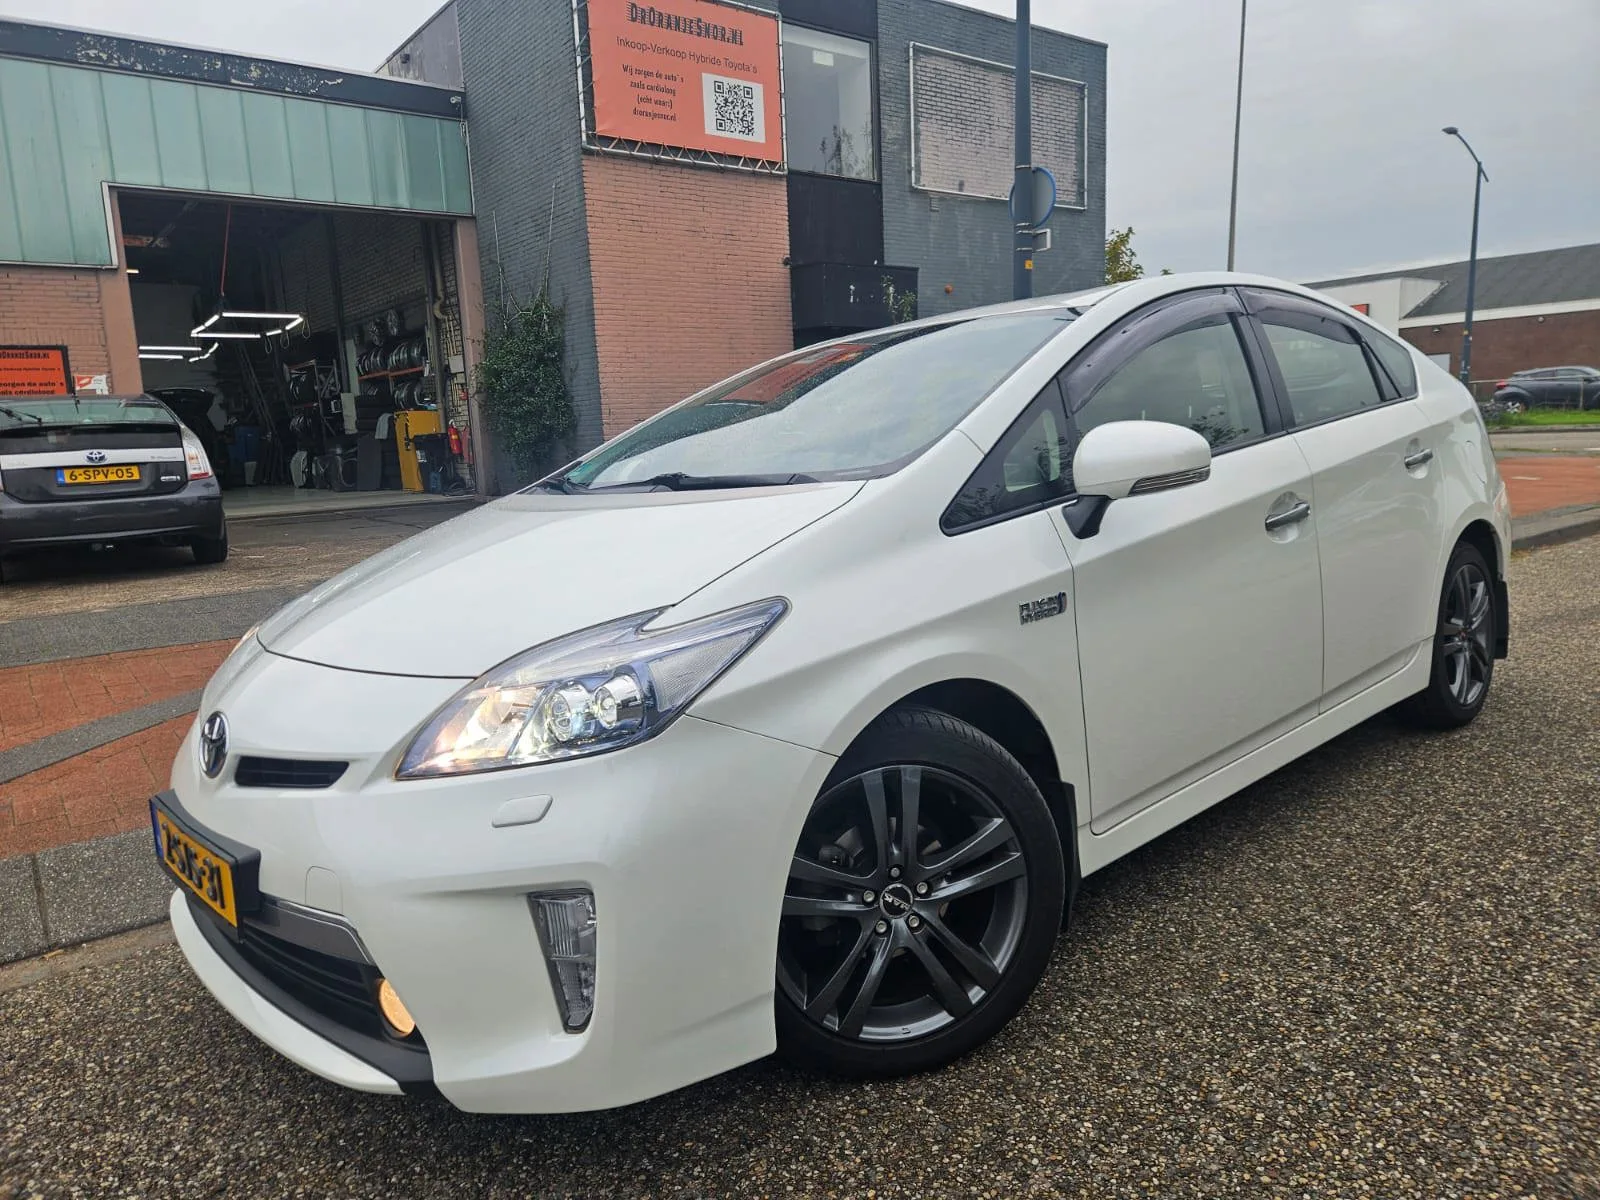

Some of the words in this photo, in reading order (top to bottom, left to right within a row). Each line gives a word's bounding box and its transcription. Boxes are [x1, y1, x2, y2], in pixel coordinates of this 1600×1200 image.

[617, 36, 687, 60] Inkoop-Verkoop
[689, 51, 721, 66] Hybride
[622, 64, 633, 75] Wij
[635, 68, 654, 78] zorgen
[69, 467, 135, 481] 6-SPV-05
